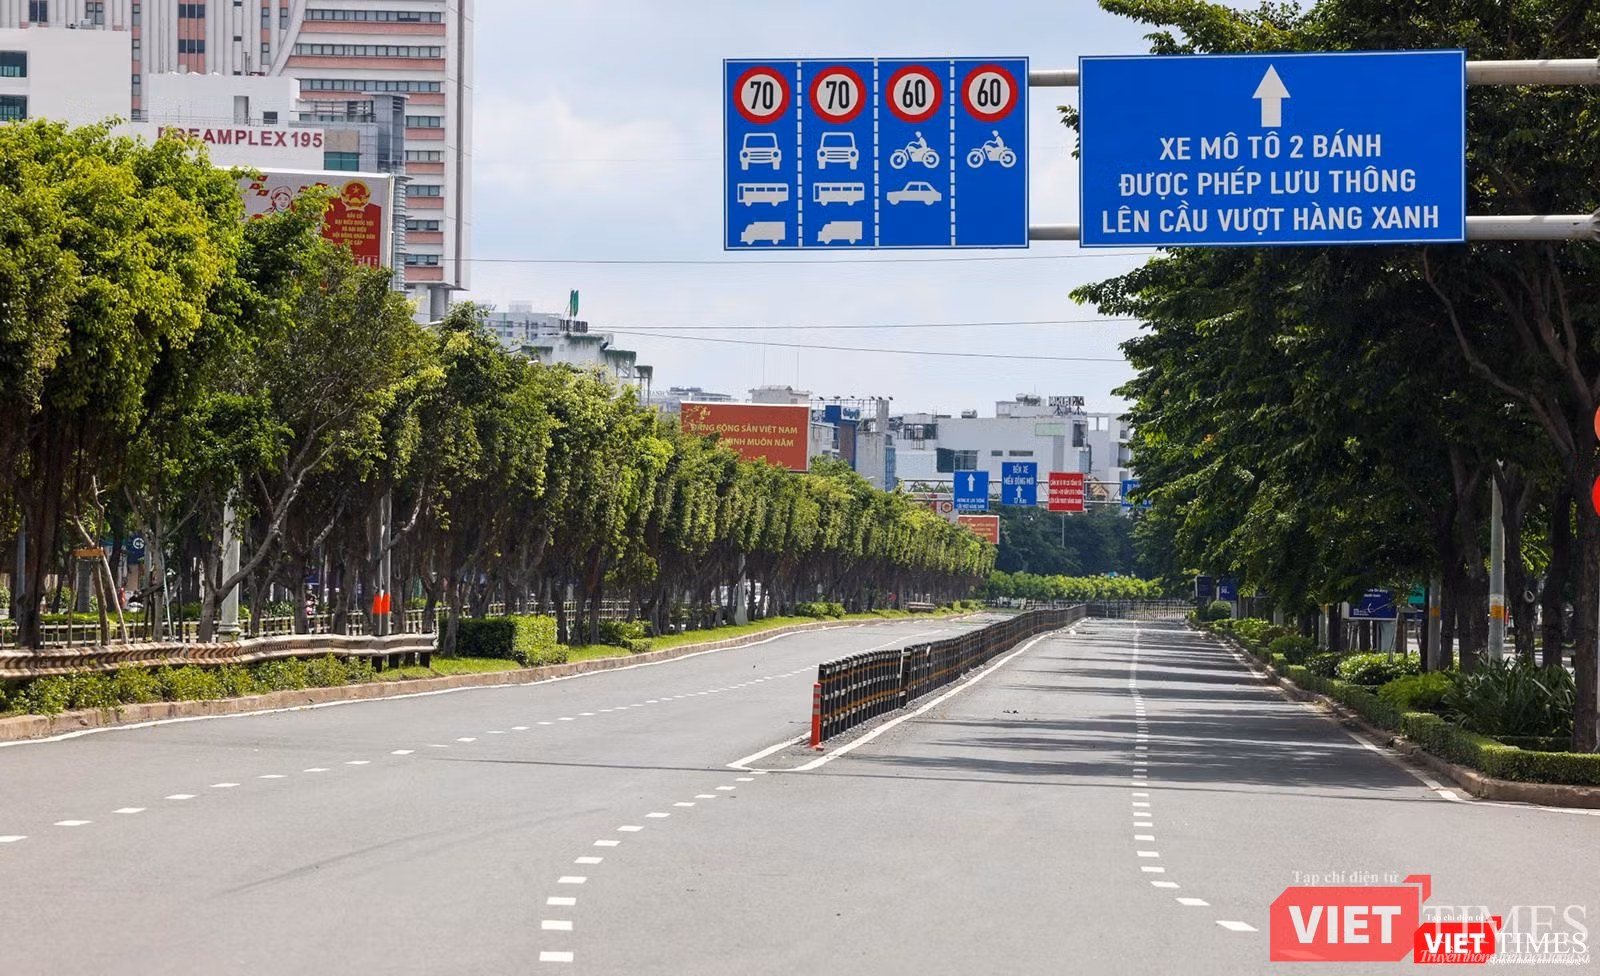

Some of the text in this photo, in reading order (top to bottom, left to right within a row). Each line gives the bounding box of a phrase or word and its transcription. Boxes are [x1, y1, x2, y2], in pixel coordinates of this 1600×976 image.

[750, 80, 774, 110] 70
[826, 80, 850, 110] 70
[902, 79, 926, 109] 60
[977, 78, 1001, 107] 60
[291, 132, 323, 148] 195
[1160, 128, 1381, 160] XE MÔ TÔ 2 BÁNH
[1118, 165, 1416, 200] ĐƯỢC PHÉP LƯU THÔNG
[1102, 200, 1439, 236] LÊN CẦU VƯỢT HÀNG XANH
[778, 426, 798, 435] NAM
